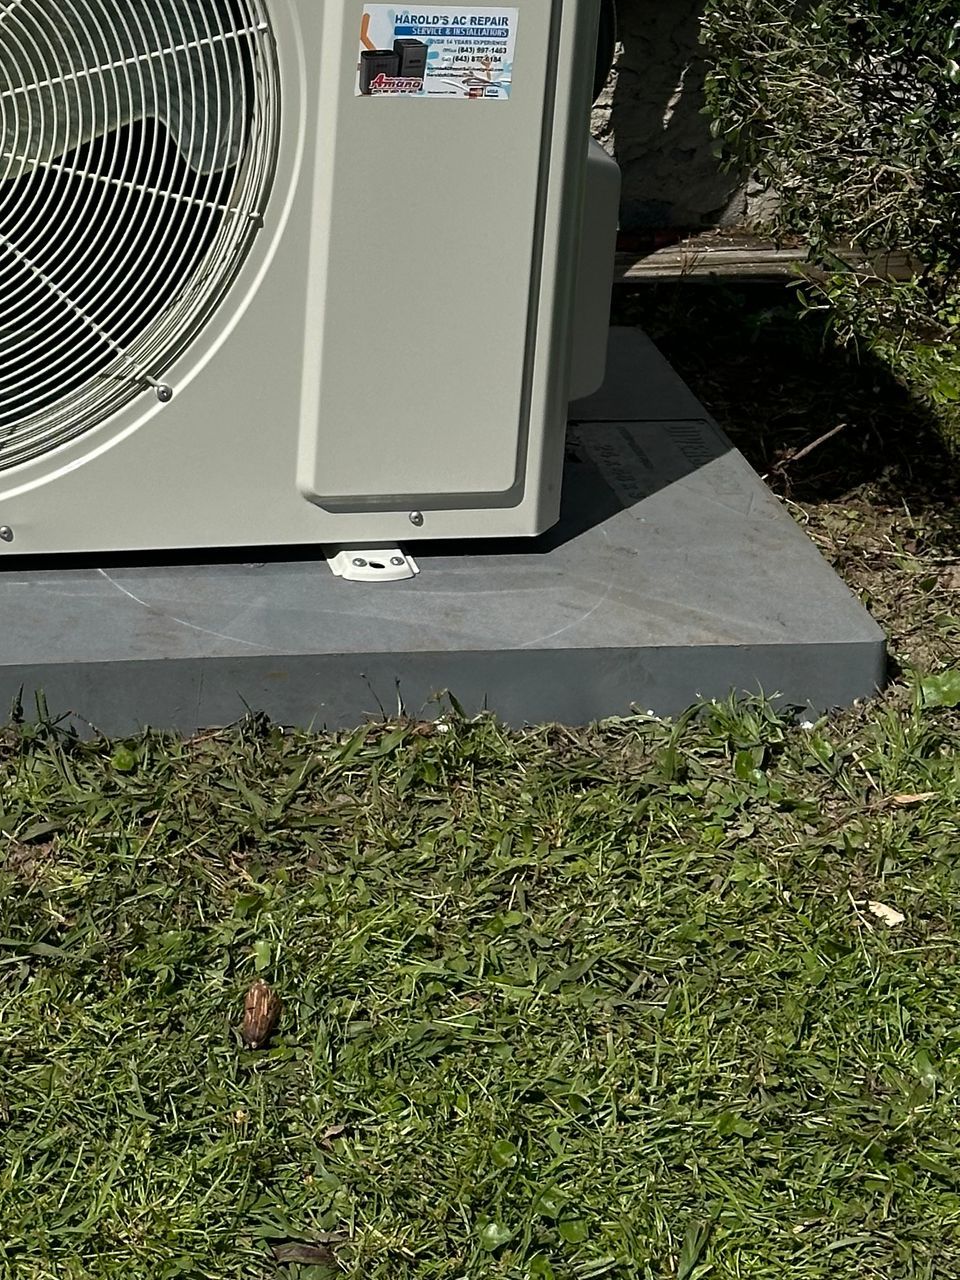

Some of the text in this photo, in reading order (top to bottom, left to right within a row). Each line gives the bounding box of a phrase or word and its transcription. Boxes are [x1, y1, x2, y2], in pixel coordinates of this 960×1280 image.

[395, 15, 509, 27] HAROLD'S AC REPAIR
[411, 27, 443, 35] SERVICE
[453, 28, 508, 37] INSTALLATIONS
[370, 73, 422, 88] Amana
